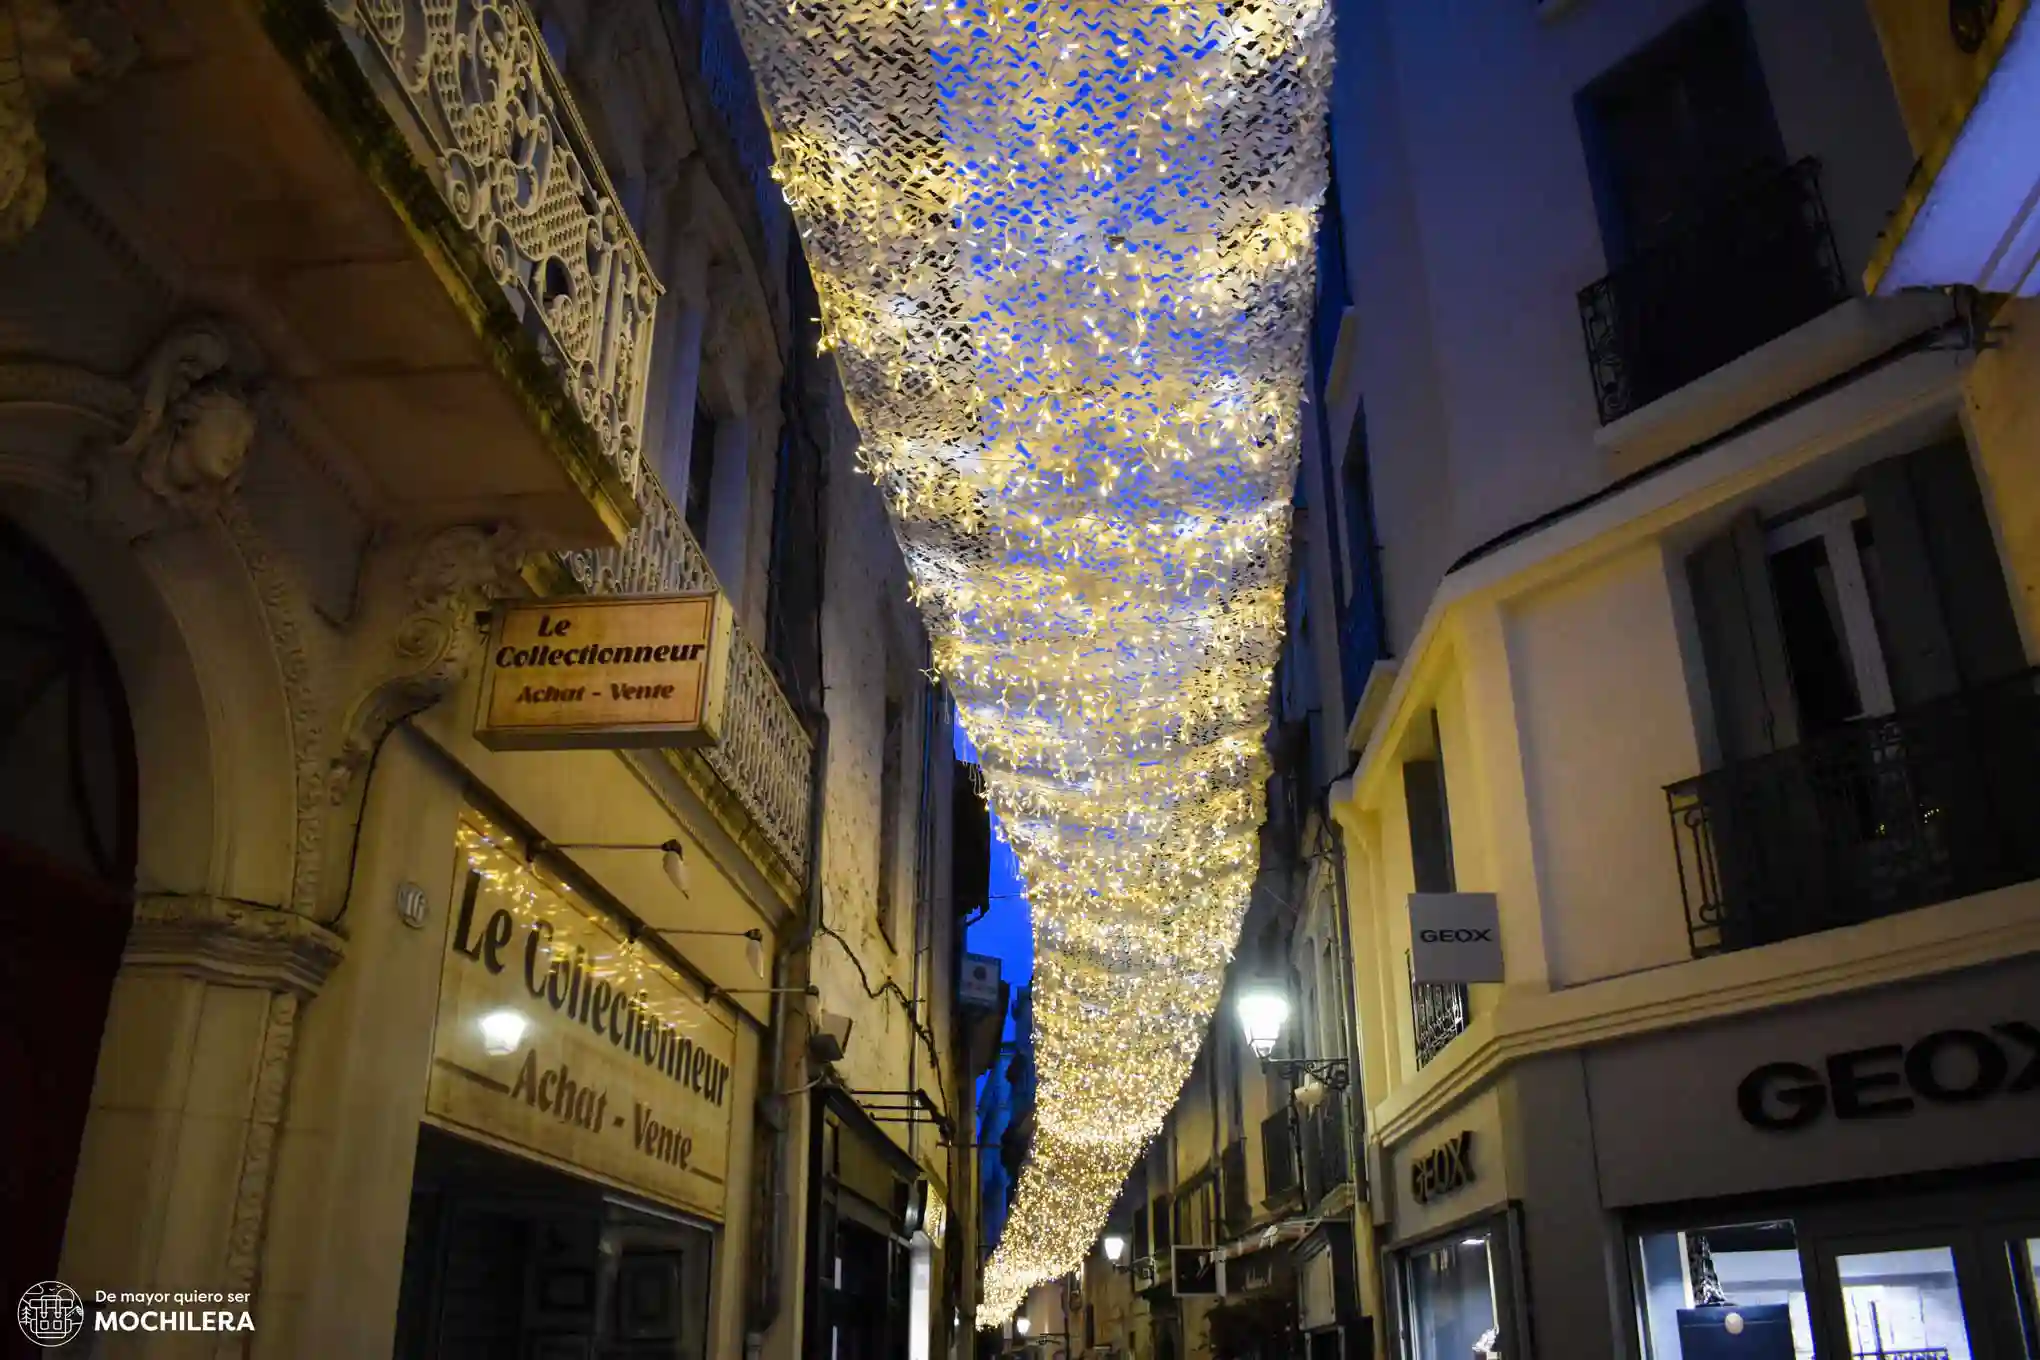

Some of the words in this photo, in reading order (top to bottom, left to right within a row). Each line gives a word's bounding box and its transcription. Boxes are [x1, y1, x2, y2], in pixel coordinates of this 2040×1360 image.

[538, 614, 571, 637] Le
[496, 643, 704, 668] Collectionneur
[517, 685, 586, 703] Achat
[610, 682, 675, 701] Vente
[1421, 928, 1492, 943] GEOX
[452, 867, 514, 975] Le
[524, 918, 729, 1107] Collectionneur
[509, 1048, 607, 1134] Achat
[634, 1099, 693, 1172] Vente
[1410, 1130, 1477, 1204] GEOX
